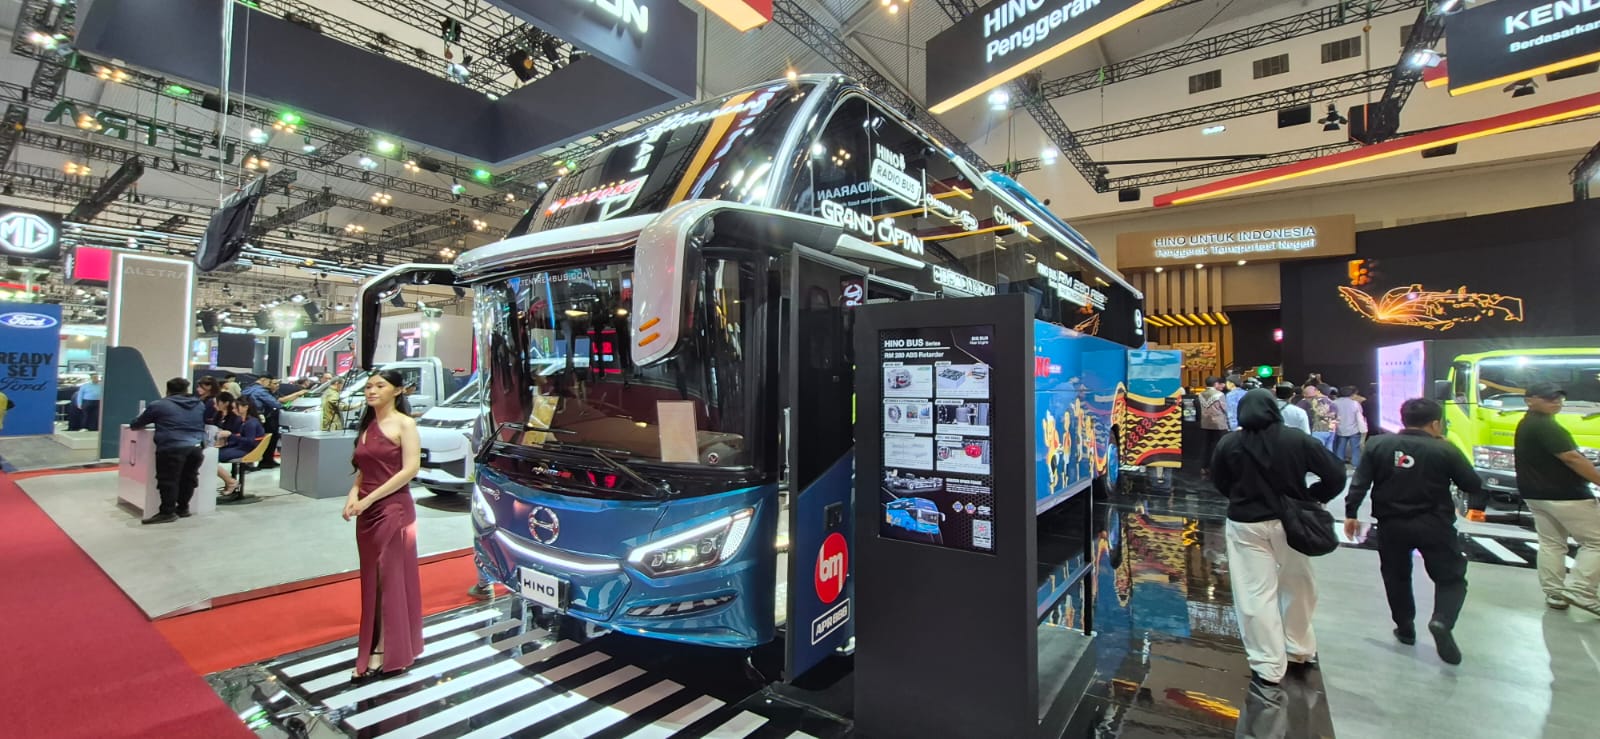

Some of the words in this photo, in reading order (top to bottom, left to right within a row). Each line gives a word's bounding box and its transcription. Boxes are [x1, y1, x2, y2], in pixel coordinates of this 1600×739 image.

[876, 143, 900, 168] HINO
[876, 164, 901, 185] RADIO
[901, 178, 915, 194] BUS
[820, 200, 875, 236] GRAND
[0, 217, 49, 249] MG
[1155, 237, 1187, 248] HINO
[1190, 233, 1235, 245] UNTUK
[1238, 226, 1316, 242] INDONESIA
[1155, 246, 1208, 258] Penggerak
[1211, 242, 1277, 255] Transportasi
[1278, 238, 1316, 251] Negeri
[884, 339, 905, 348] HINO
[906, 338, 924, 347] BUS
[0, 352, 54, 365] READY
[8, 364, 40, 377] SET
[0, 377, 48, 391] Ford
[523, 577, 555, 597] HINO
[815, 616, 833, 636] APR
